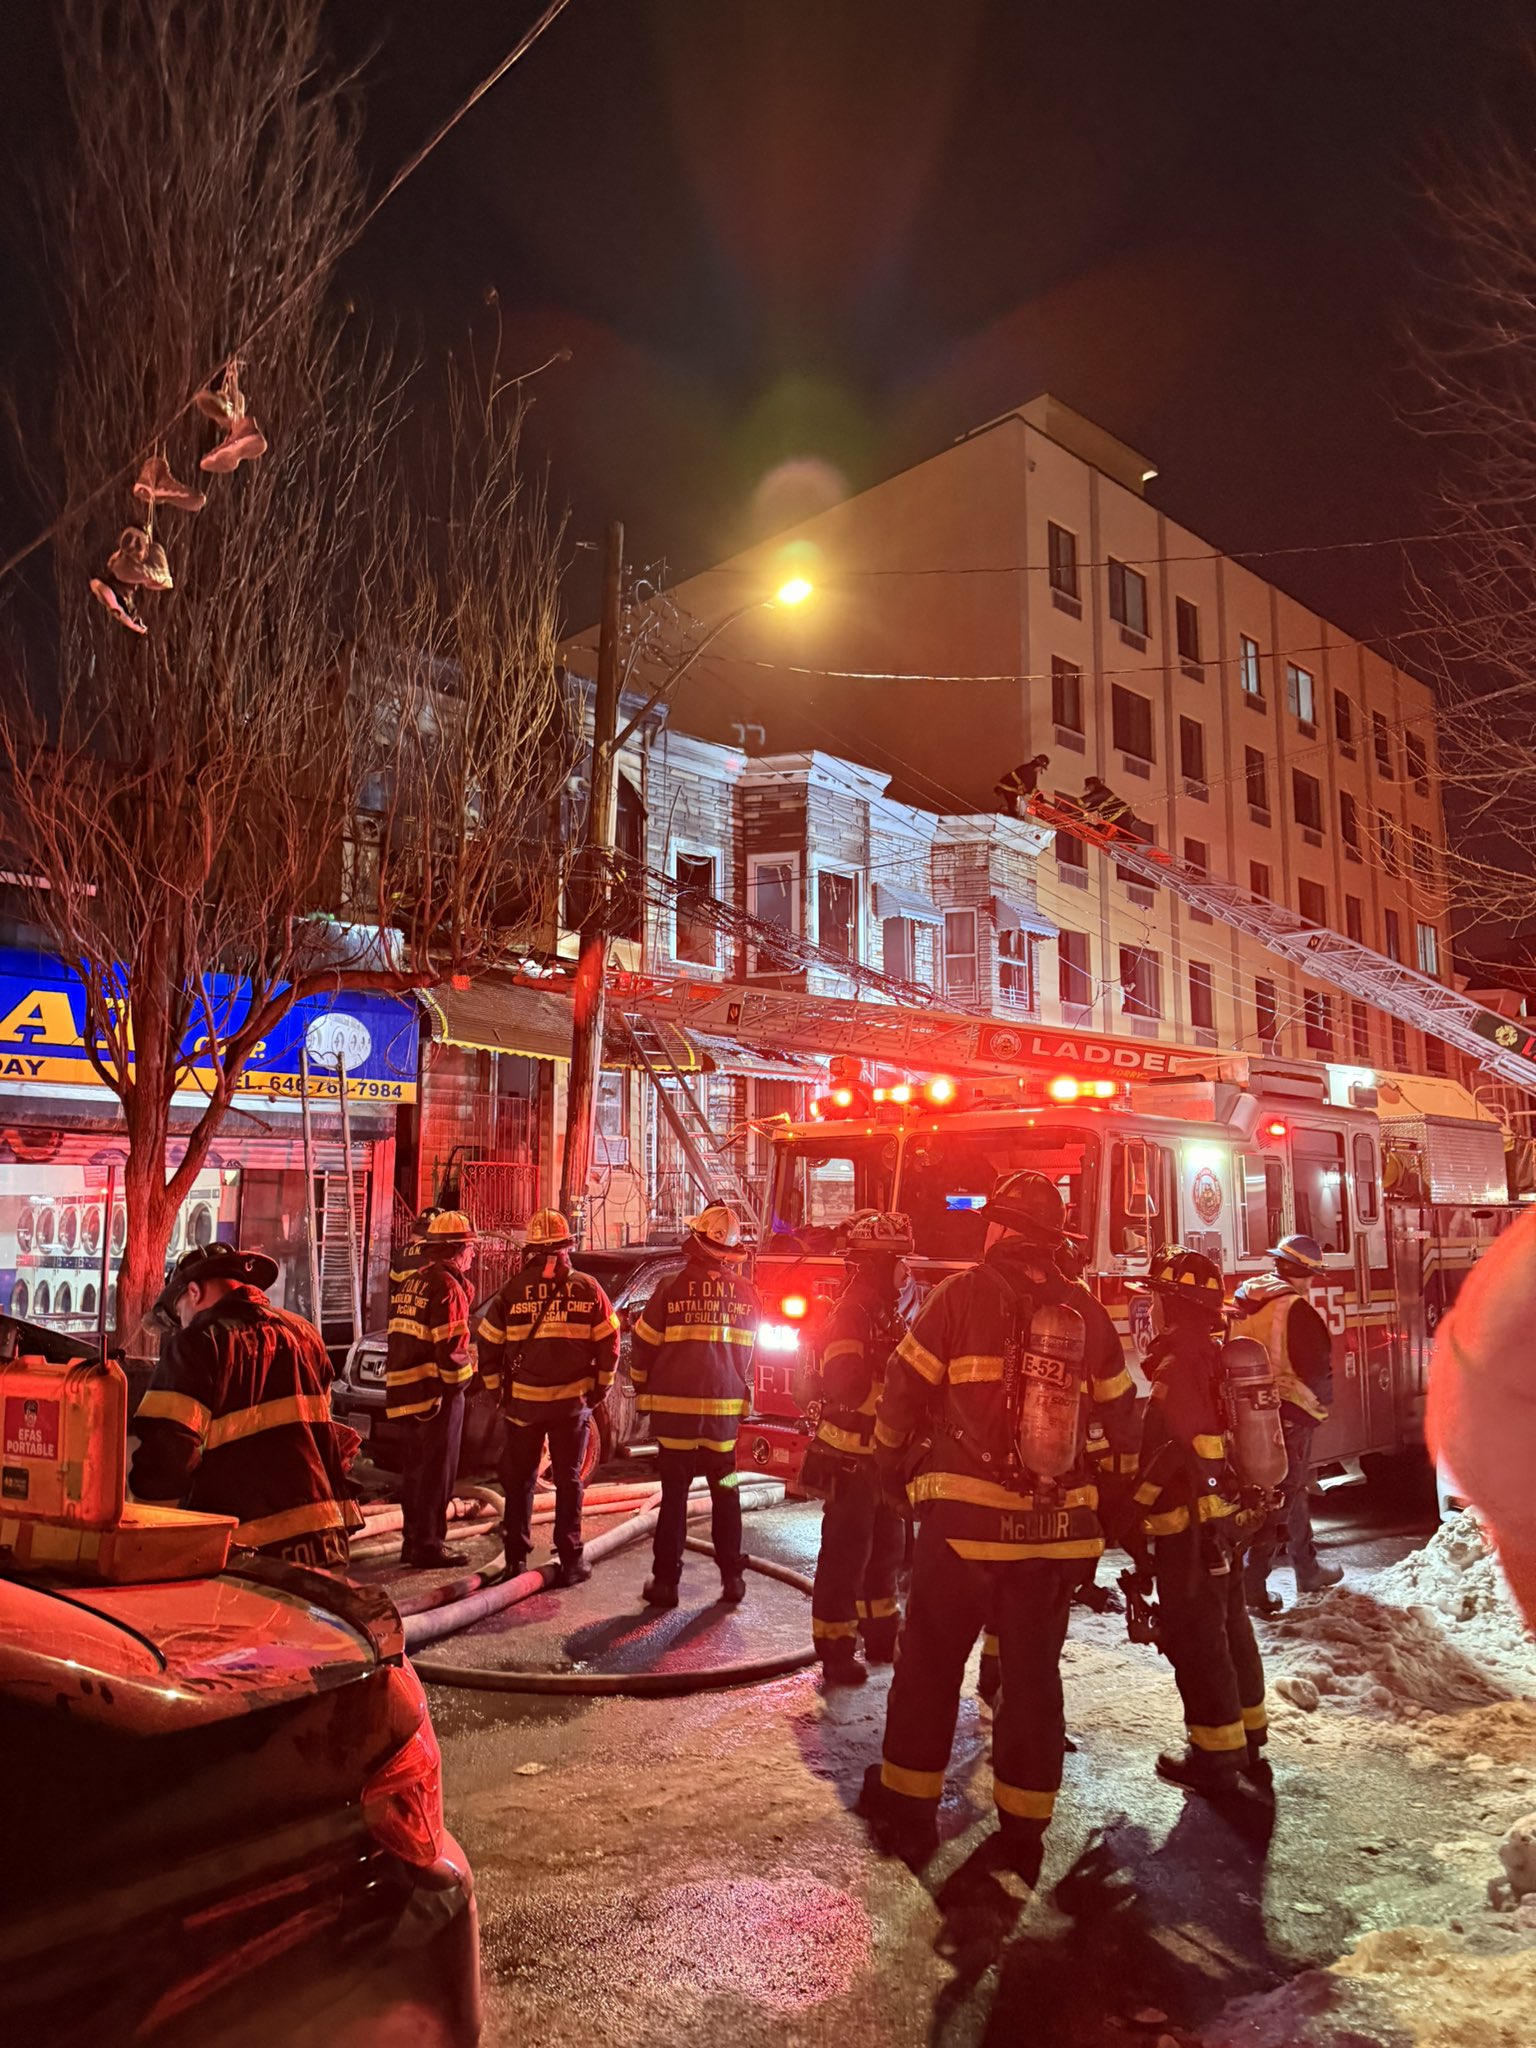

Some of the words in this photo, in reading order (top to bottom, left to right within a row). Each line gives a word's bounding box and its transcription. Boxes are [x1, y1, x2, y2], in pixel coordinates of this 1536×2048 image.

[0, 1057, 45, 1076] AY
[270, 1075, 403, 1098] 646-76-7984
[510, 1300, 561, 1315] ASSISTNT
[567, 1301, 595, 1313] CHIEF
[668, 1300, 720, 1314] BATTALION
[727, 1301, 753, 1317] CHIEF
[531, 1310, 568, 1323] DGGAN
[685, 1312, 737, 1325] O'SULLIVAN
[1024, 1355, 1061, 1380] E-52
[18, 1428, 42, 1442] EFAS
[6, 1440, 54, 1457] PORTABLE
